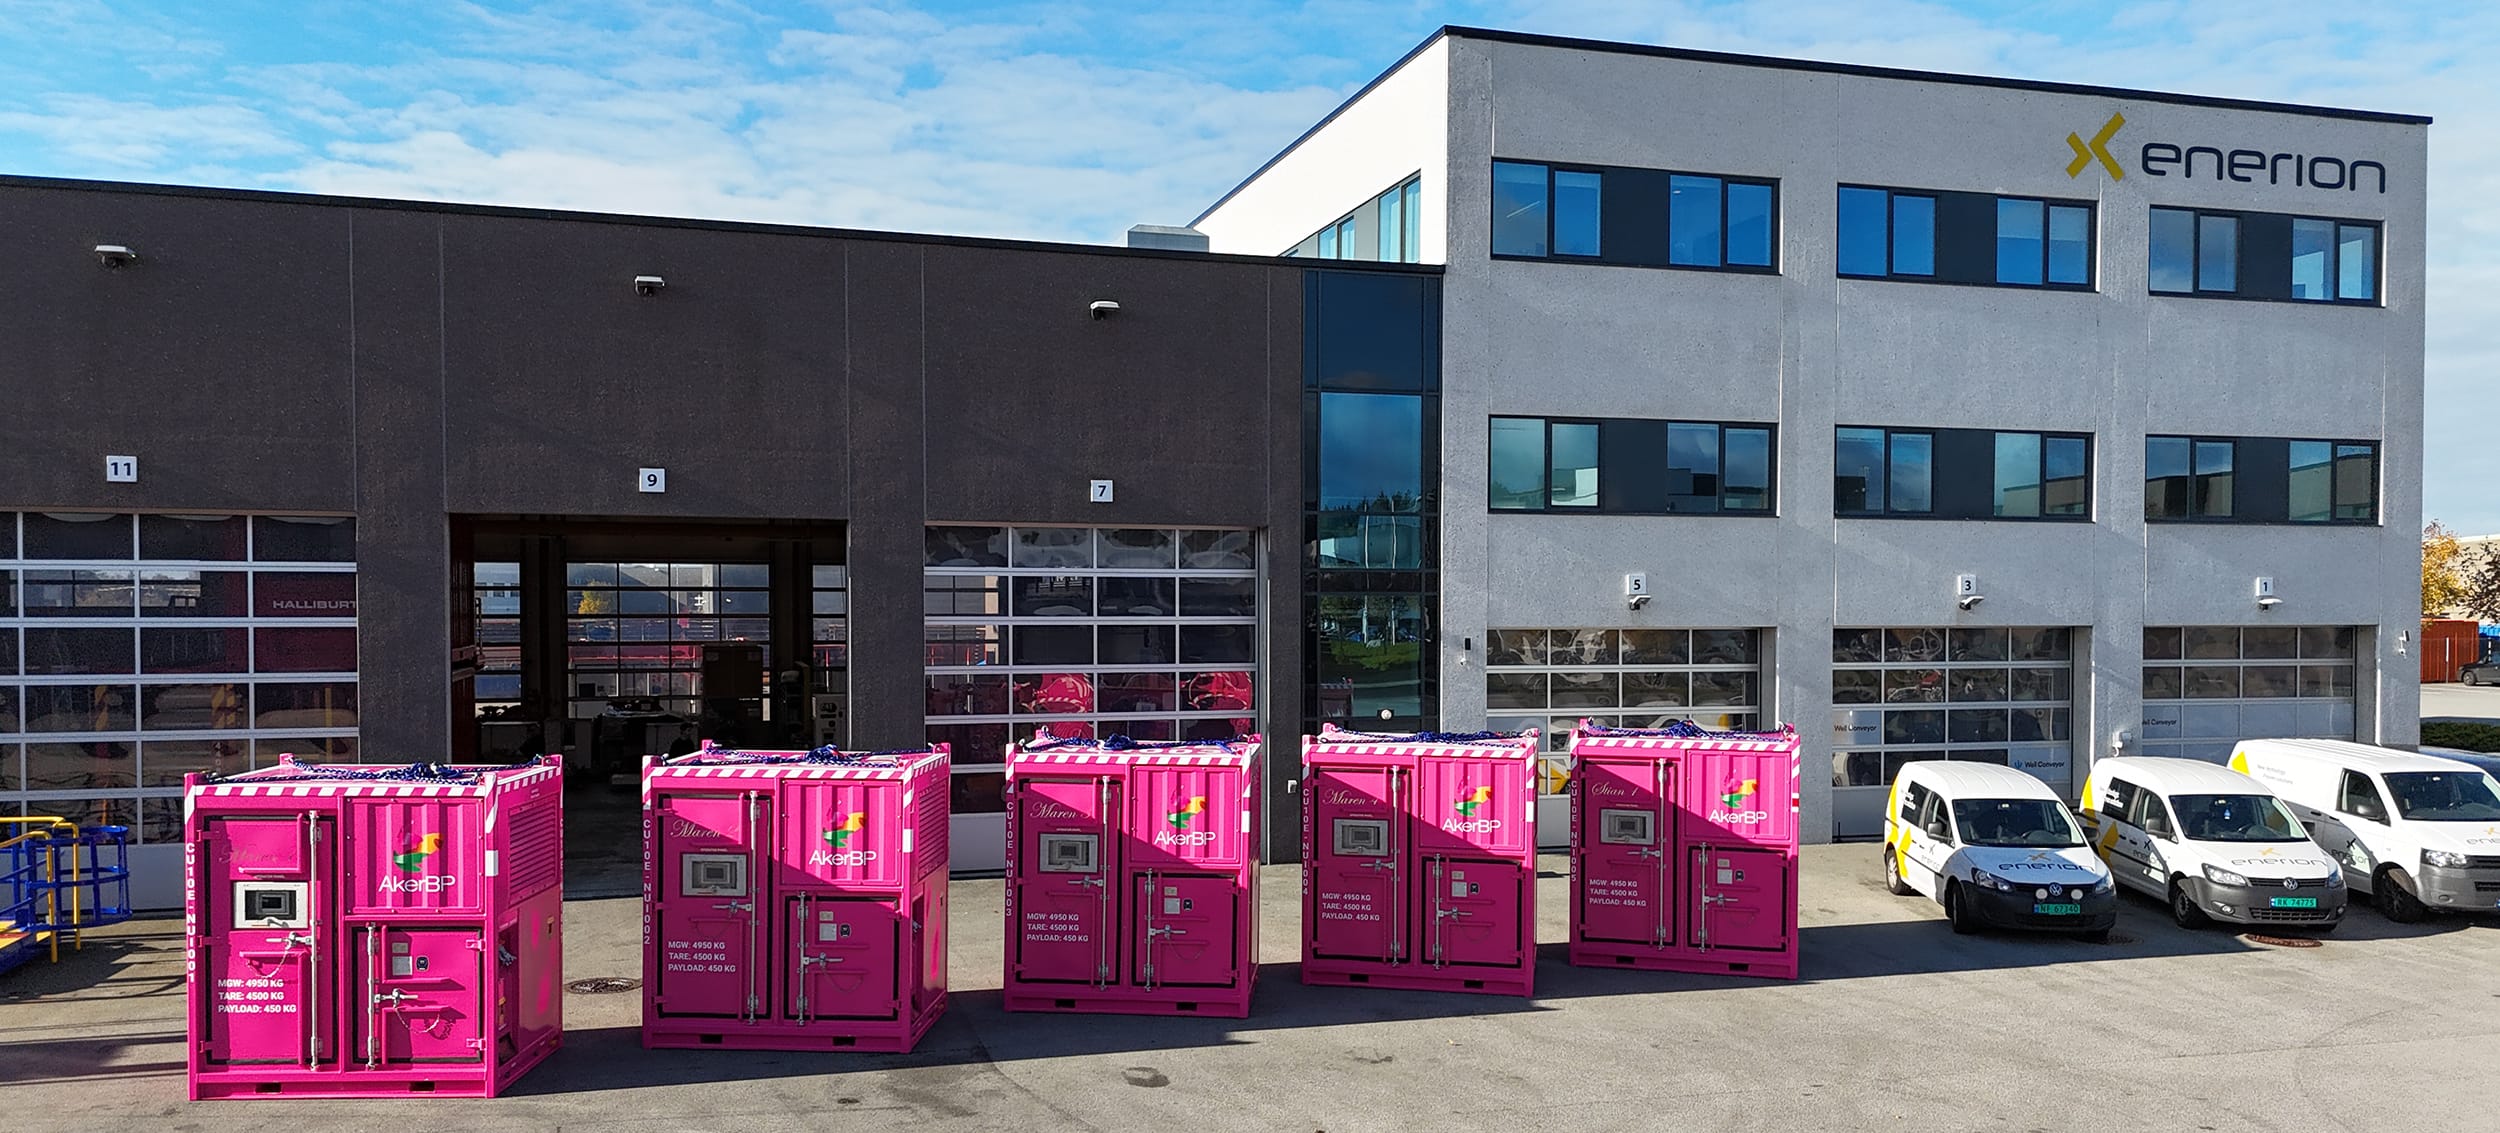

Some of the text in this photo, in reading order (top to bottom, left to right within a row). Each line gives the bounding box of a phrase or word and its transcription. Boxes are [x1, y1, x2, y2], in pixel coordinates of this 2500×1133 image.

[2141, 142, 2386, 194] enerion
[110, 462, 131, 476] 11
[647, 473, 658, 487] 9
[1098, 485, 1107, 497] 7
[1633, 579, 1641, 591] 5
[1964, 580, 1972, 591] 3
[2263, 581, 2268, 592] 1
[1322, 788, 1366, 805] Maren
[1030, 801, 1077, 818] Maren
[1708, 809, 1767, 824] AkerBP
[670, 819, 721, 838] Maren
[1442, 818, 1501, 833] AkerBP
[1153, 831, 1216, 846] AkerBP
[808, 849, 877, 866] AkerBP
[2231, 858, 2327, 866] enerion
[1998, 862, 2095, 872] enerion
[378, 875, 456, 892] AkerBP
[1343, 893, 1360, 901] 4950
[1343, 903, 1360, 911] 4500
[1049, 913, 1067, 921] 4950
[1063, 934, 1077, 942] 450
[668, 941, 691, 949] MGW:
[692, 941, 712, 949] 4950
[693, 953, 713, 961] 4500
[714, 953, 725, 961] KG
[668, 964, 707, 972] PAYLOAD:
[218, 979, 284, 988] MGW: 4950 KG
[218, 991, 285, 1000] TARE: 4500 KG
[218, 1004, 297, 1013] PAYLOAD: 450 KG
